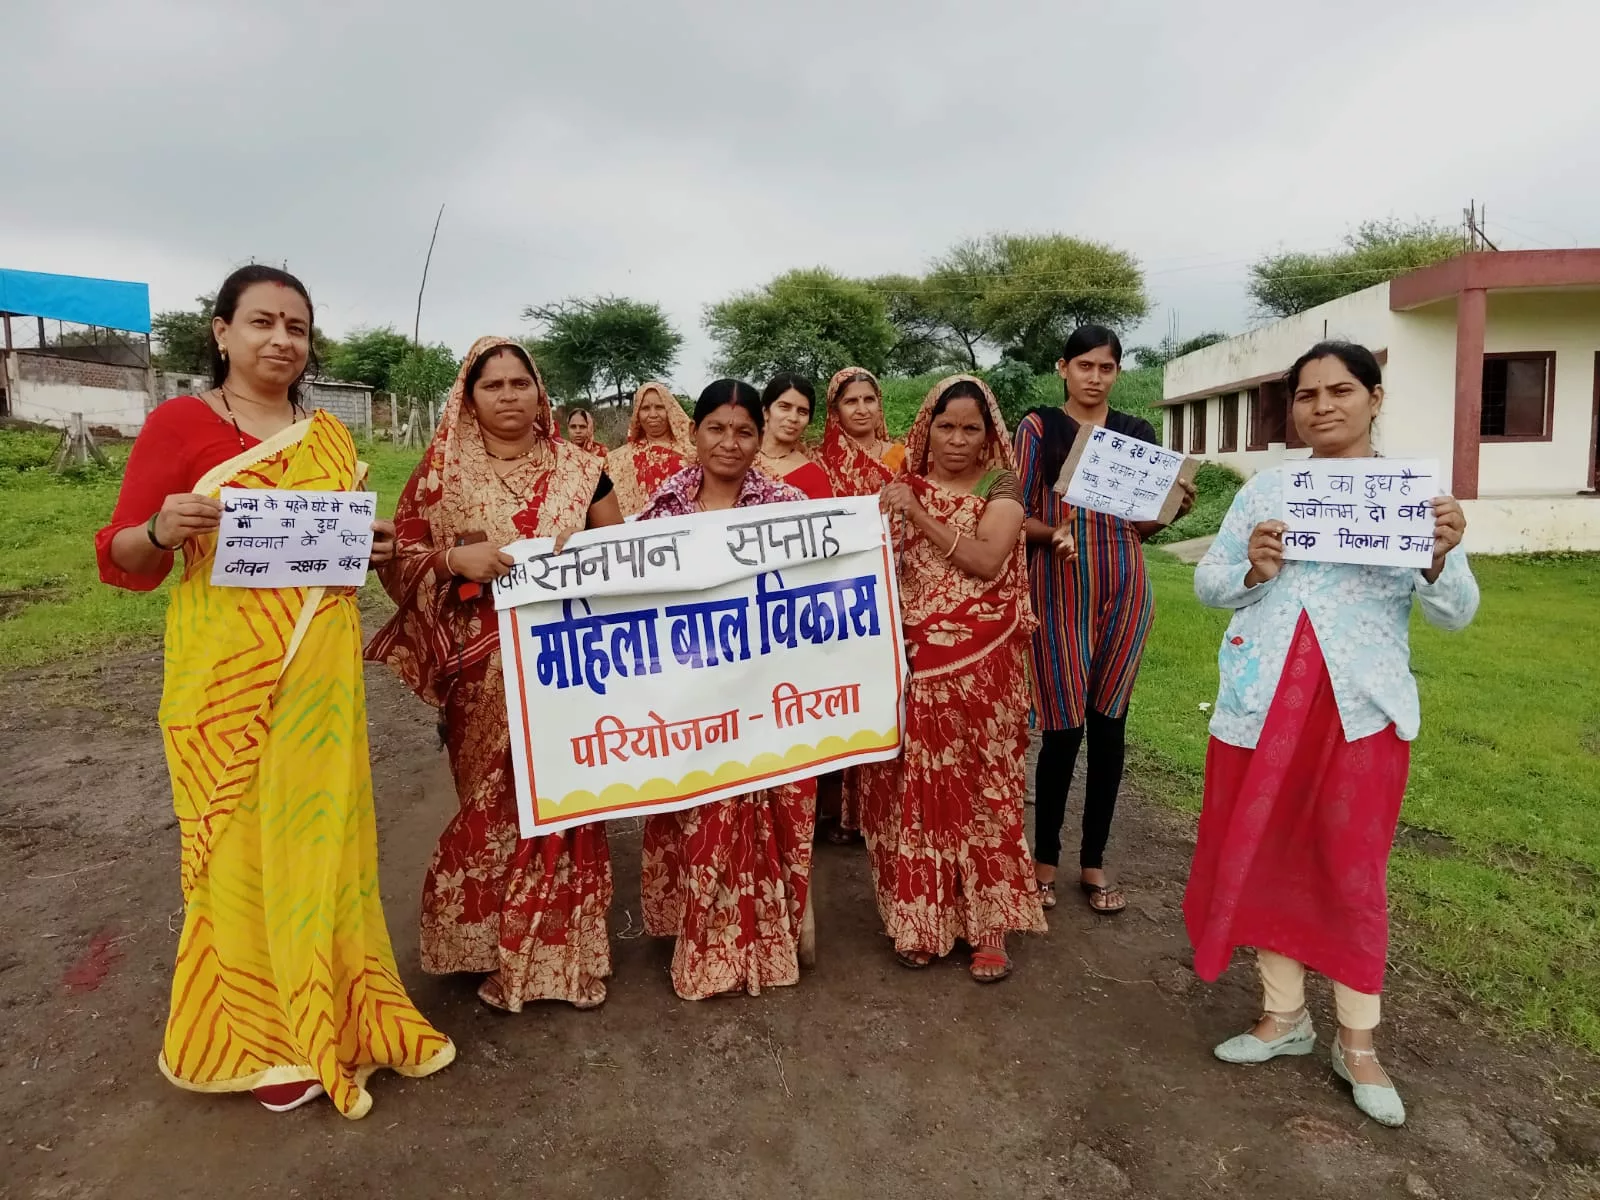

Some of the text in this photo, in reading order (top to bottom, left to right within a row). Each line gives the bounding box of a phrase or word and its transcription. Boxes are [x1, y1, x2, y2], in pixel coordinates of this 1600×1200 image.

[1110, 461, 1136, 478] समान
[1328, 475, 1353, 494] का
[1400, 468, 1432, 495] है
[225, 498, 260, 512] जन्म
[264, 495, 278, 510] के
[284, 495, 308, 513] पहले
[349, 500, 373, 516] सिर्फ
[1365, 500, 1386, 522] दो
[1398, 500, 1434, 521] वर्ष
[280, 518, 295, 528] का
[226, 536, 288, 550] नवजात
[301, 531, 320, 546] के
[530, 529, 691, 590] स्तनपान
[727, 509, 855, 565] सप्ताह
[1285, 531, 1320, 549] तक
[1334, 528, 1390, 550] पिलाना
[225, 559, 269, 576] जीवन
[286, 559, 329, 573] रक्षक
[531, 570, 881, 695] महिला बाल विकास
[571, 710, 739, 767] परियोजना
[773, 682, 861, 729] तिरला
